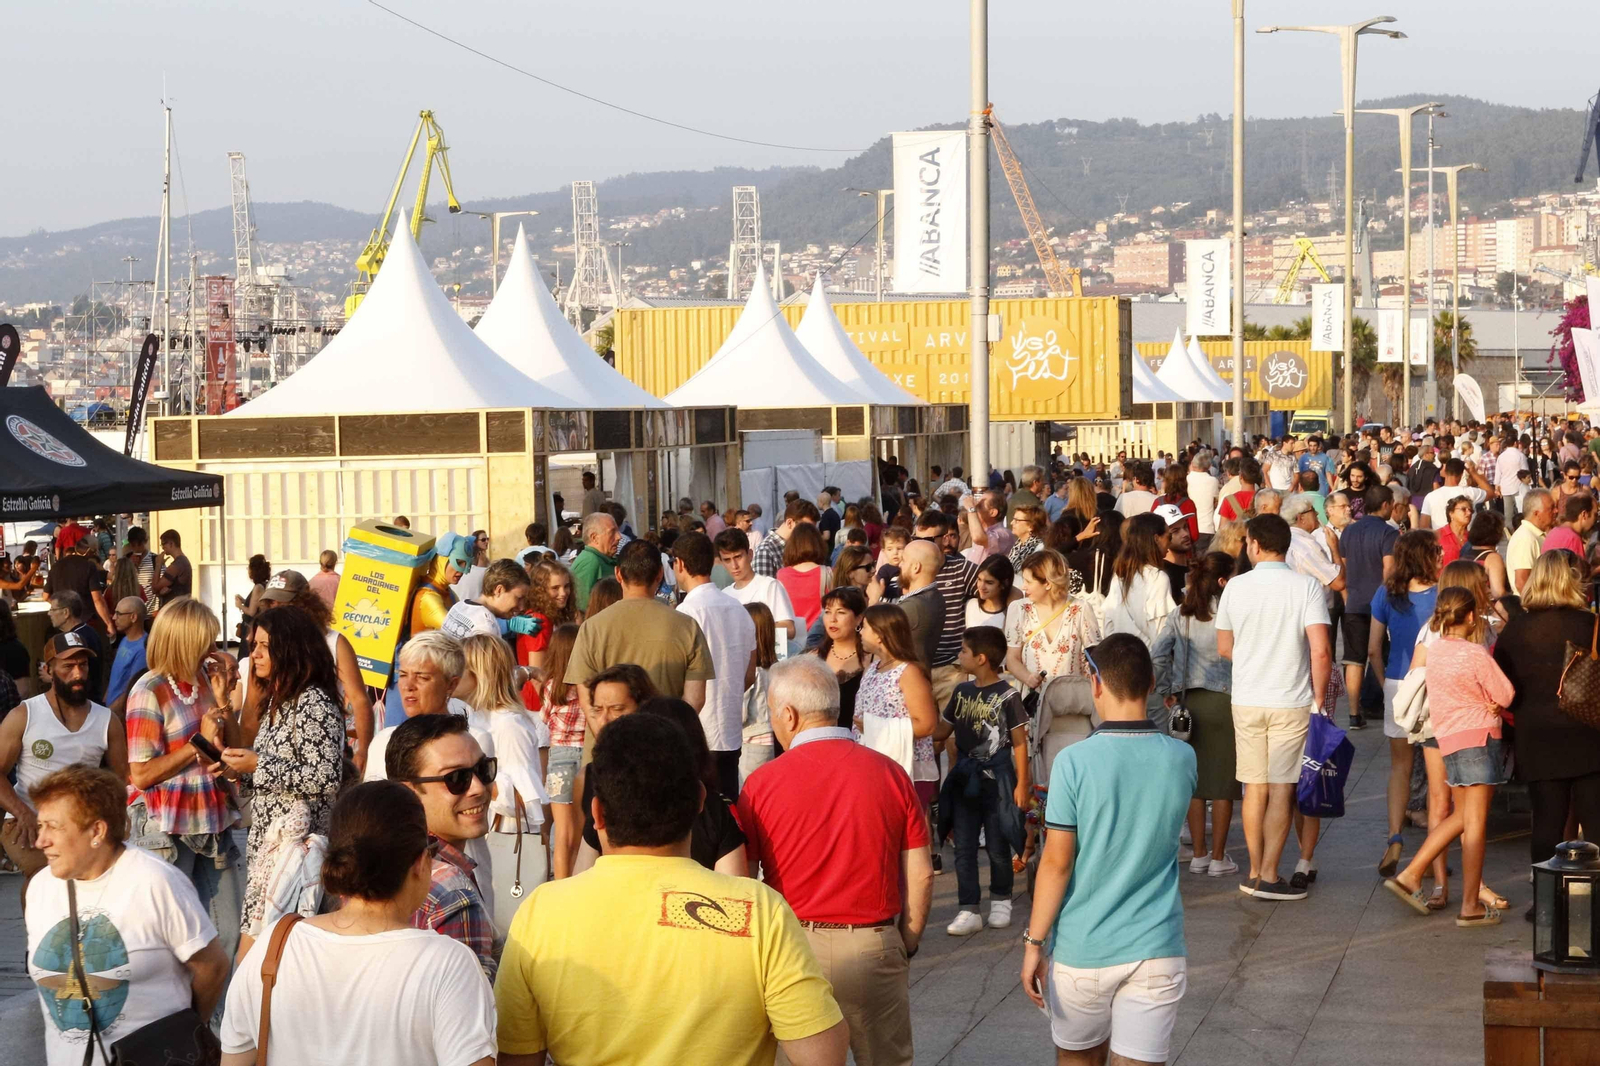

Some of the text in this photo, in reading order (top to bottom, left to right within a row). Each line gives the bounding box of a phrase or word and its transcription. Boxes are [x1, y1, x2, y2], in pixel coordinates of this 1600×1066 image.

[845, 331, 967, 348] TIVAL ARV
[938, 373, 969, 385] 201
[370, 570, 385, 580] LOS
[352, 573, 400, 592] GUARDIANES
[366, 585, 381, 595] DEL
[342, 612, 391, 626] RECICLAJE
